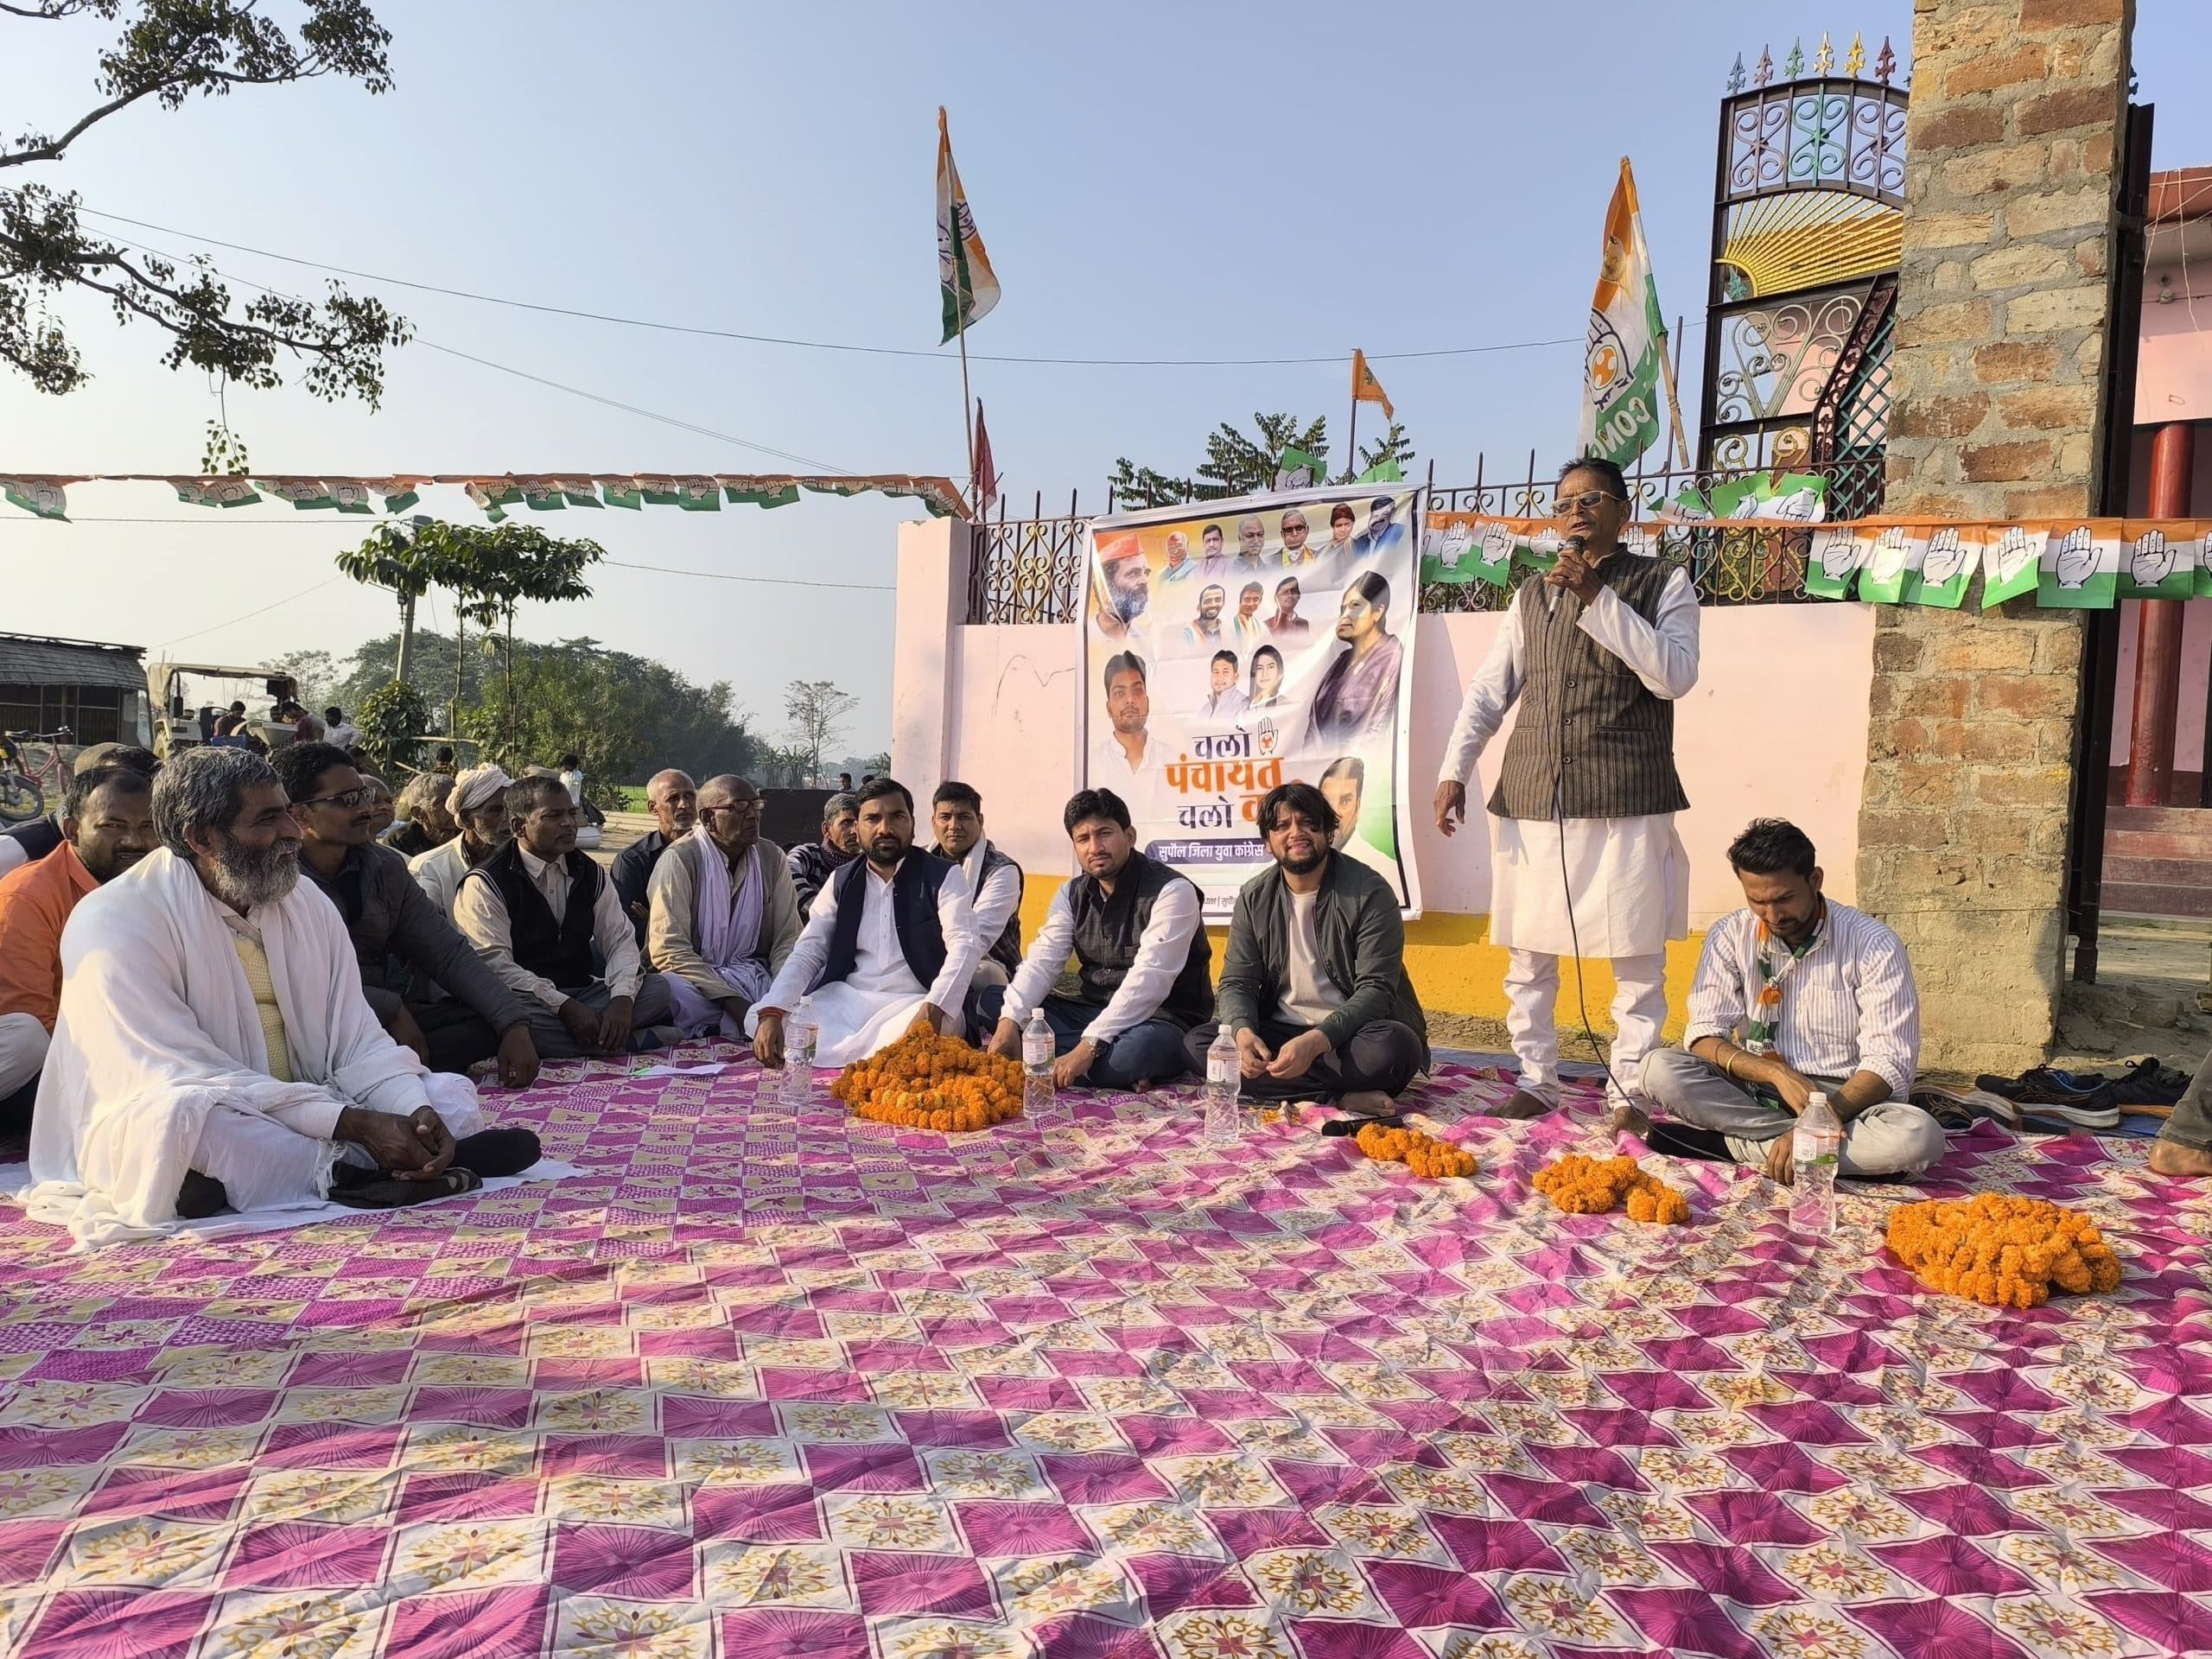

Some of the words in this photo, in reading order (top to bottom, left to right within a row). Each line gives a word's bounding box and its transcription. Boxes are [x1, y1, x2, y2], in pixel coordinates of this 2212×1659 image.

[1192, 725, 1253, 760] चलो
[1164, 753, 1285, 794] पंचायत
[1177, 796, 1236, 829] चलो
[1158, 842, 1187, 862] सुपौल
[1188, 842, 1214, 858] जिला
[1215, 844, 1233, 861] युवा
[1234, 841, 1265, 858] कांग्रेस
